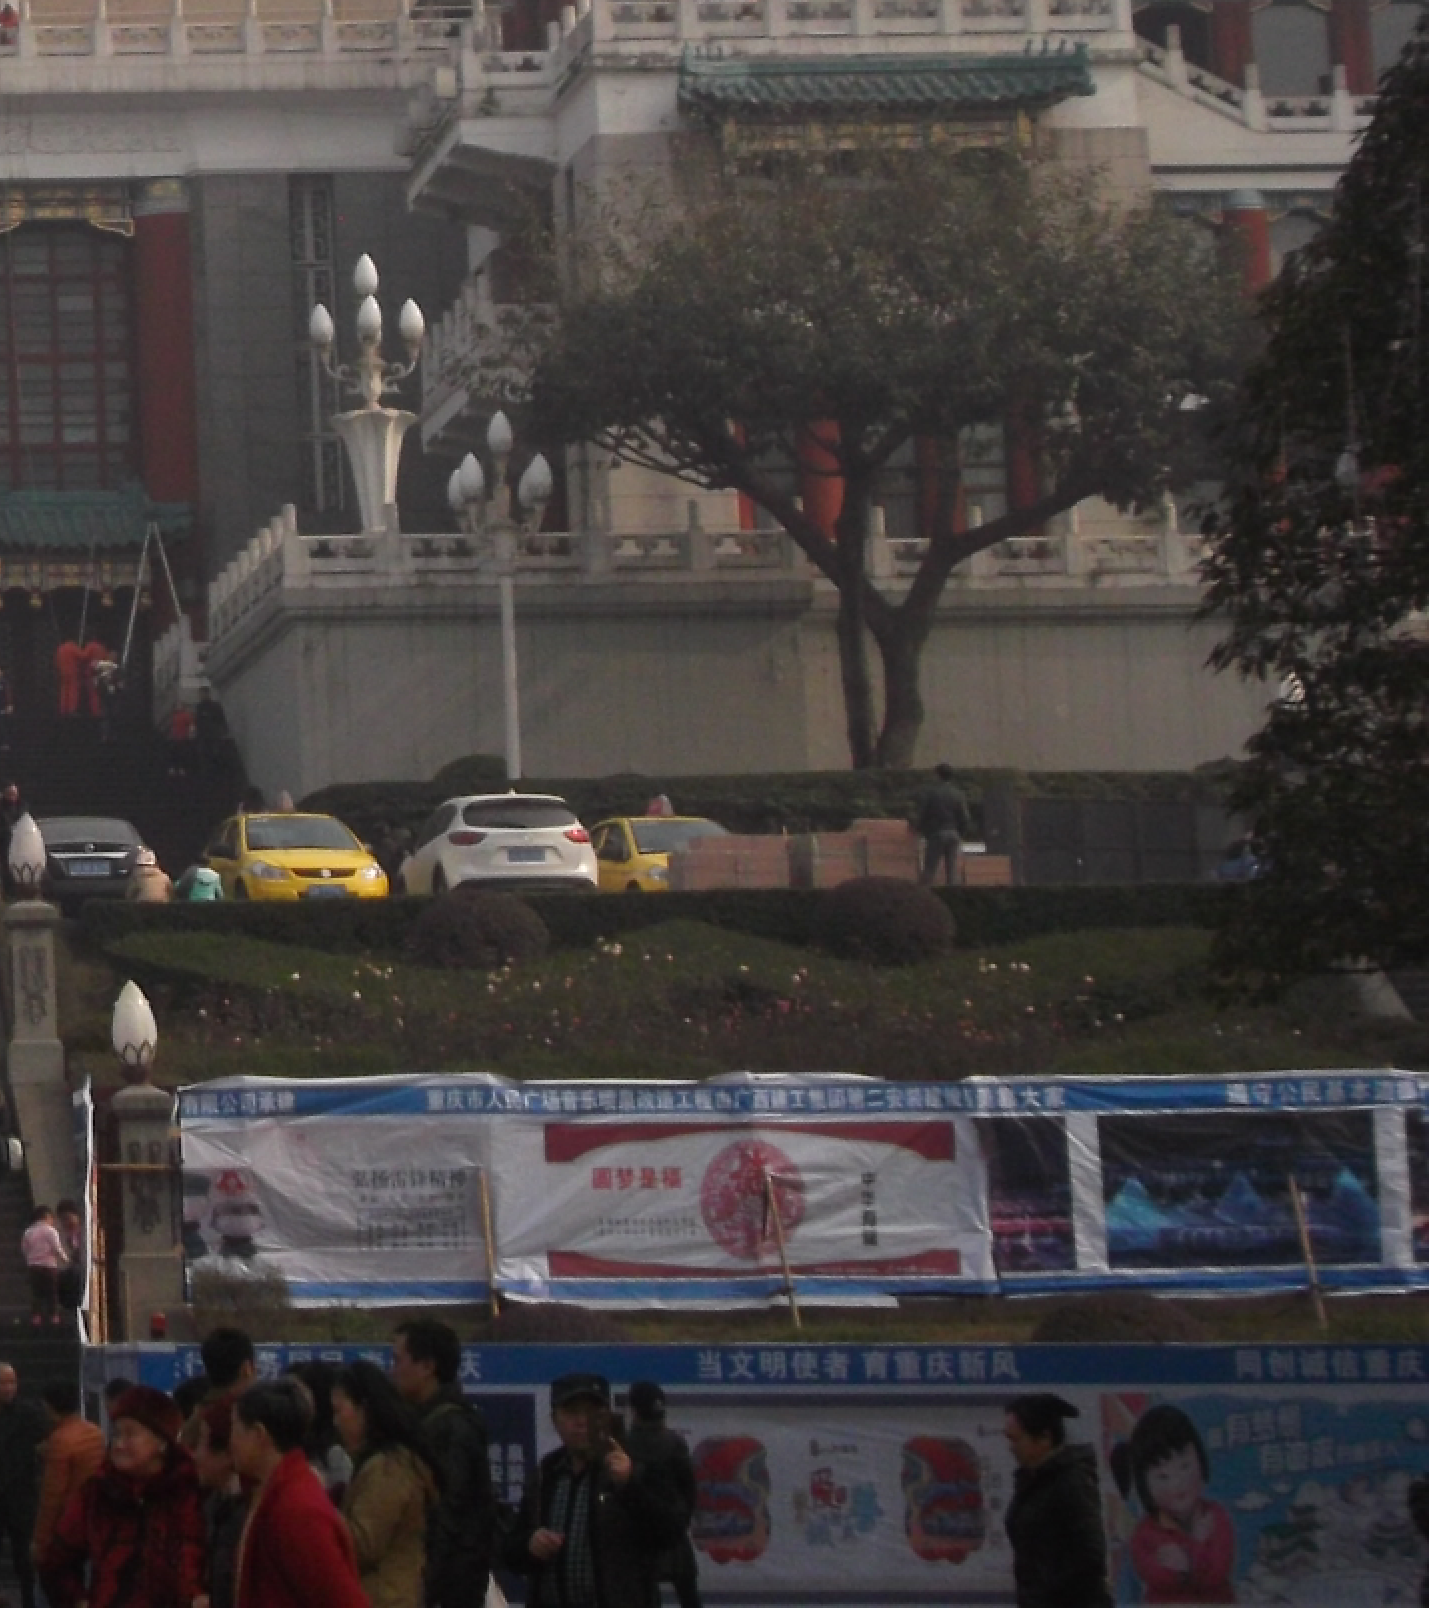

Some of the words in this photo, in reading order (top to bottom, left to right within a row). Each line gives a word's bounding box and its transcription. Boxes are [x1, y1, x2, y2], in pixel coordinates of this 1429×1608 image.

[697, 1349, 849, 1381] 当文明使者
